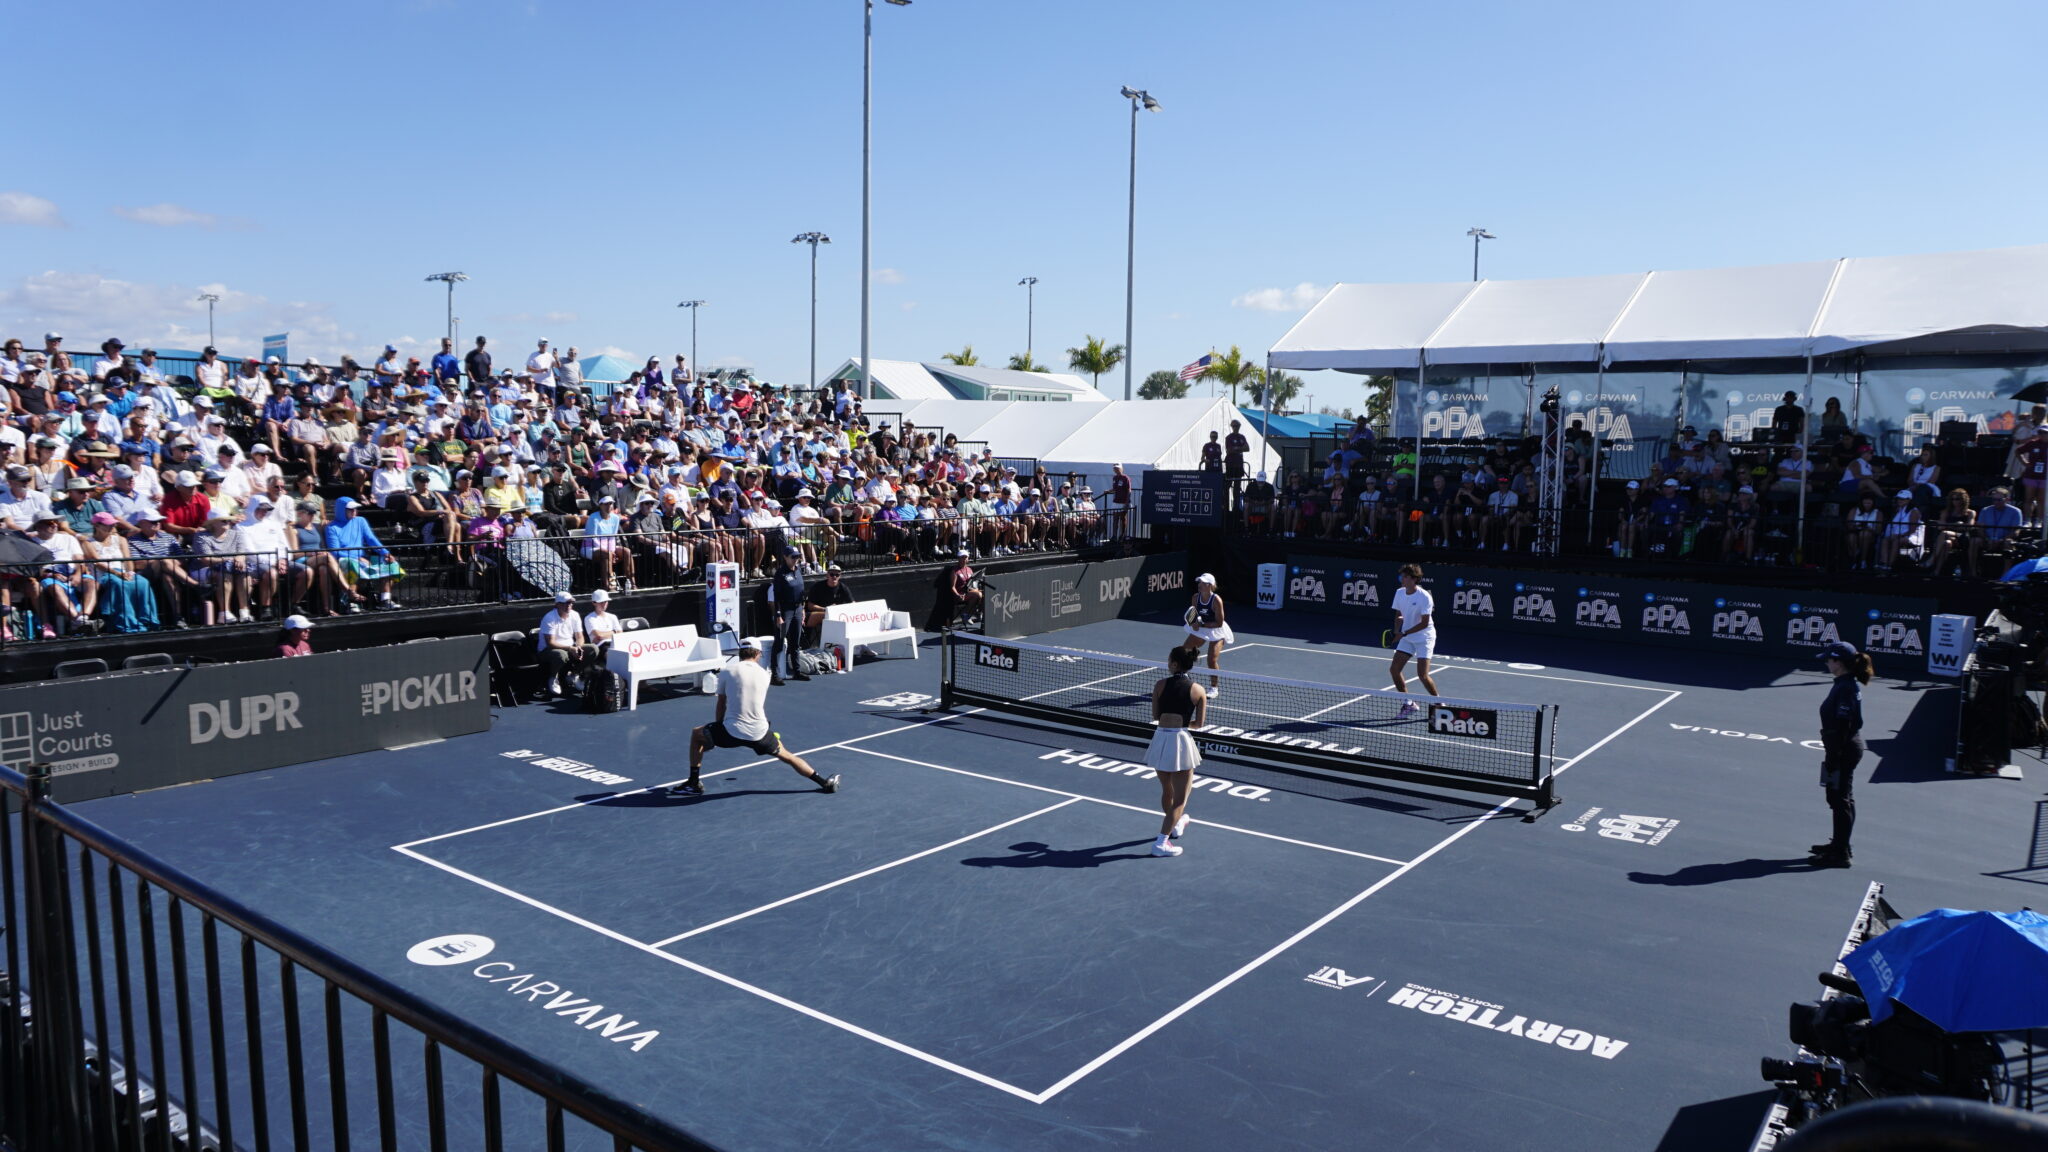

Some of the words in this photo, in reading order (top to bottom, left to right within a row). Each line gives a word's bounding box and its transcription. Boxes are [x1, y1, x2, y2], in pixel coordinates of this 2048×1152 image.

[1442, 393, 1489, 402] CARVANA
[1746, 393, 1804, 402] CARVA
[1930, 390, 1996, 400] CARVANA
[1422, 406, 1486, 441] PPA
[1193, 491, 1199, 500] 7
[1204, 492, 1210, 500] 0
[1183, 504, 1188, 512] 7
[1203, 505, 1209, 513] 0
[1060, 581, 1074, 592] Just
[1099, 576, 1132, 602] DUPR
[1152, 571, 1184, 592] PICKLR
[1290, 575, 1326, 598] PPA
[1342, 579, 1379, 603] PPA
[1002, 591, 1032, 623] Kitchen
[1061, 591, 1081, 603] Courts
[1453, 588, 1495, 613] PPA
[1512, 593, 1557, 618] PPA
[849, 611, 879, 623] VEOLIA
[1576, 598, 1622, 624] PPA
[1642, 604, 1691, 630] PPA
[1712, 609, 1764, 637] PPA
[1786, 615, 1841, 644] PPA
[1865, 621, 1924, 650] PPA
[644, 639, 686, 653] VEOLIA
[978, 648, 1014, 669] Rate
[361, 683, 373, 717] THE
[372, 670, 477, 715] PICKLR
[37, 711, 84, 733] Just
[189, 691, 304, 745] DUPR
[1434, 708, 1490, 736] Rate
[39, 732, 113, 756] Courts
[1669, 723, 1793, 744] VEOLIA
[1195, 741, 1240, 755] LKIRK
[51, 763, 80, 773] ESIGN
[87, 756, 114, 768] BUILD
[1039, 749, 1272, 802] Humna
[1598, 814, 1669, 844] PPA
[1406, 982, 1460, 999] COATINGS
[473, 961, 660, 1053] CARVANA
[1461, 996, 1505, 1011] SPORTS
[1387, 987, 1630, 1060] ACRYTECH
